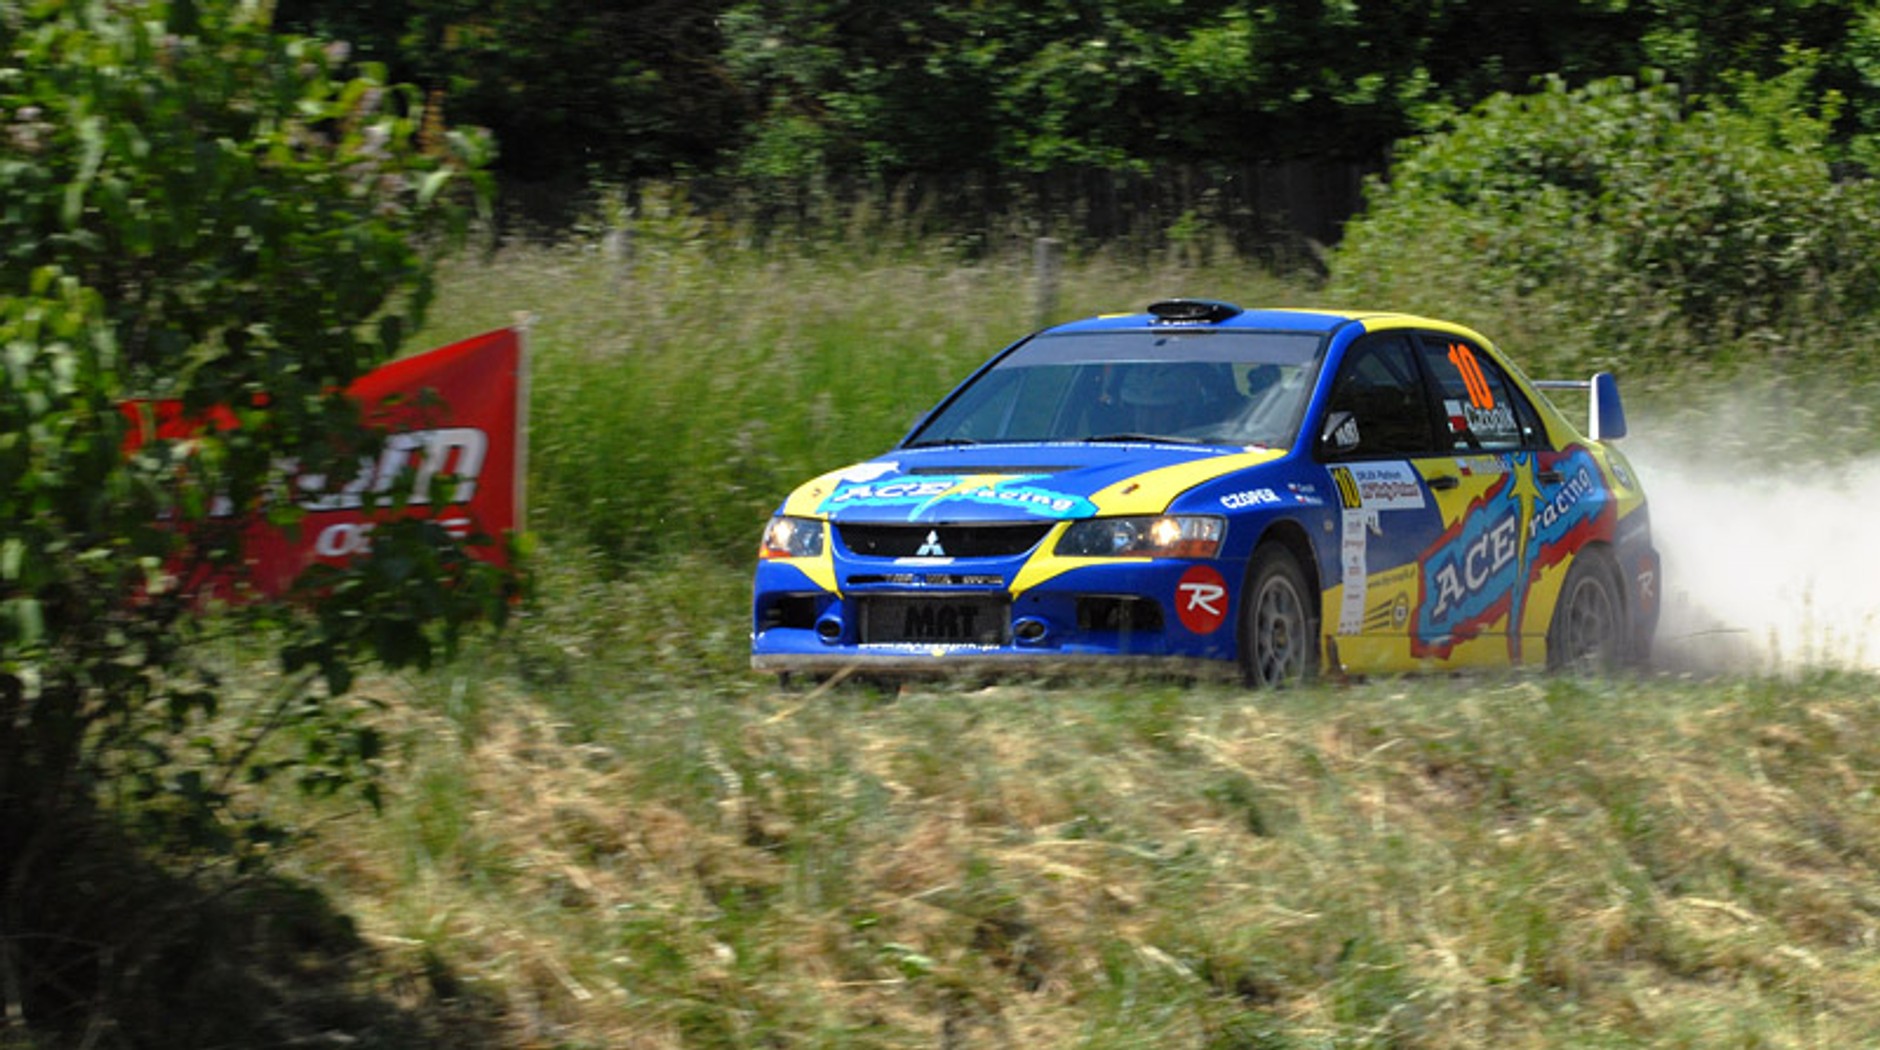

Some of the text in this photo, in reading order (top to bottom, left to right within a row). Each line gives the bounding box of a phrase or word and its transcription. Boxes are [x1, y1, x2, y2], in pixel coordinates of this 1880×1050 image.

[1447, 342, 1495, 411] 10
[833, 480, 1077, 512] ACE racing
[1333, 466, 1362, 509] 10
[1432, 514, 1516, 617] ACE
[1528, 467, 1593, 538] racing
[1179, 582, 1225, 616] R
